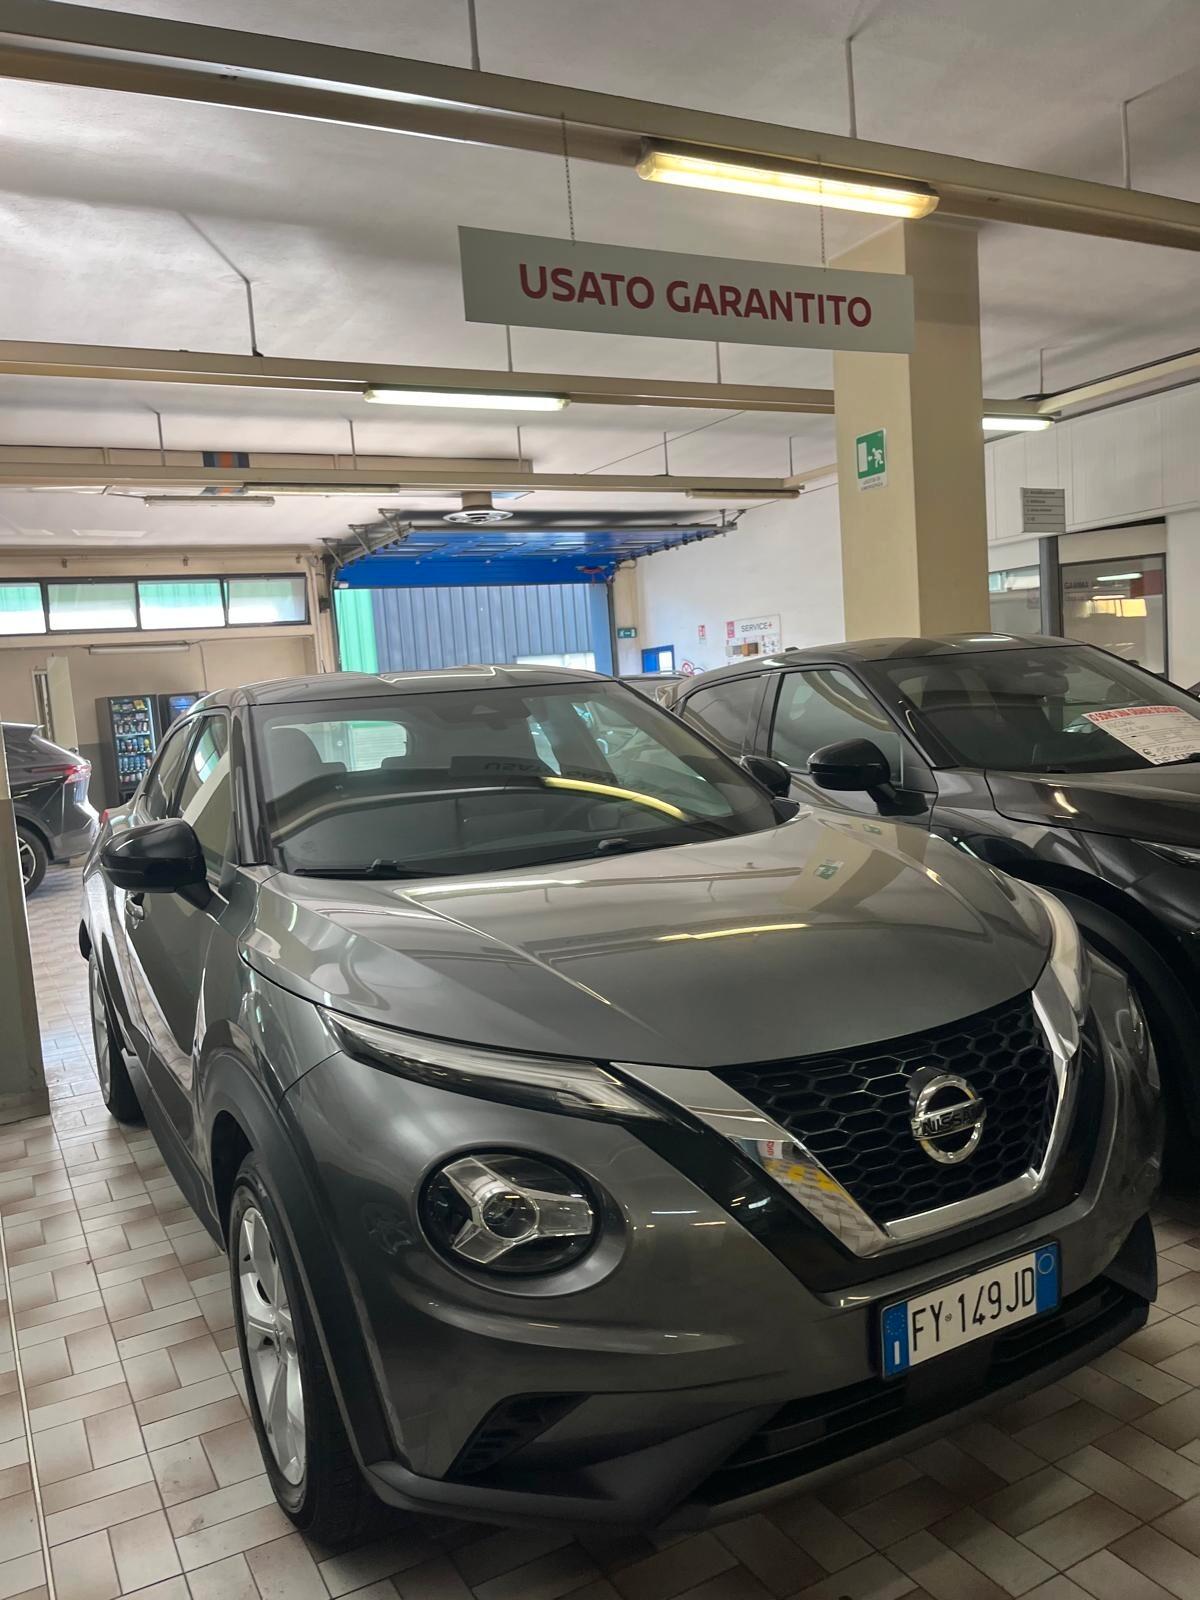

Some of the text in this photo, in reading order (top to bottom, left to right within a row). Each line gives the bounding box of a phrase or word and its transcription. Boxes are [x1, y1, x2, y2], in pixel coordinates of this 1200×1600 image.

[519, 263, 872, 328] USATO GARANTITO
[922, 1106, 978, 1136] NISSA
